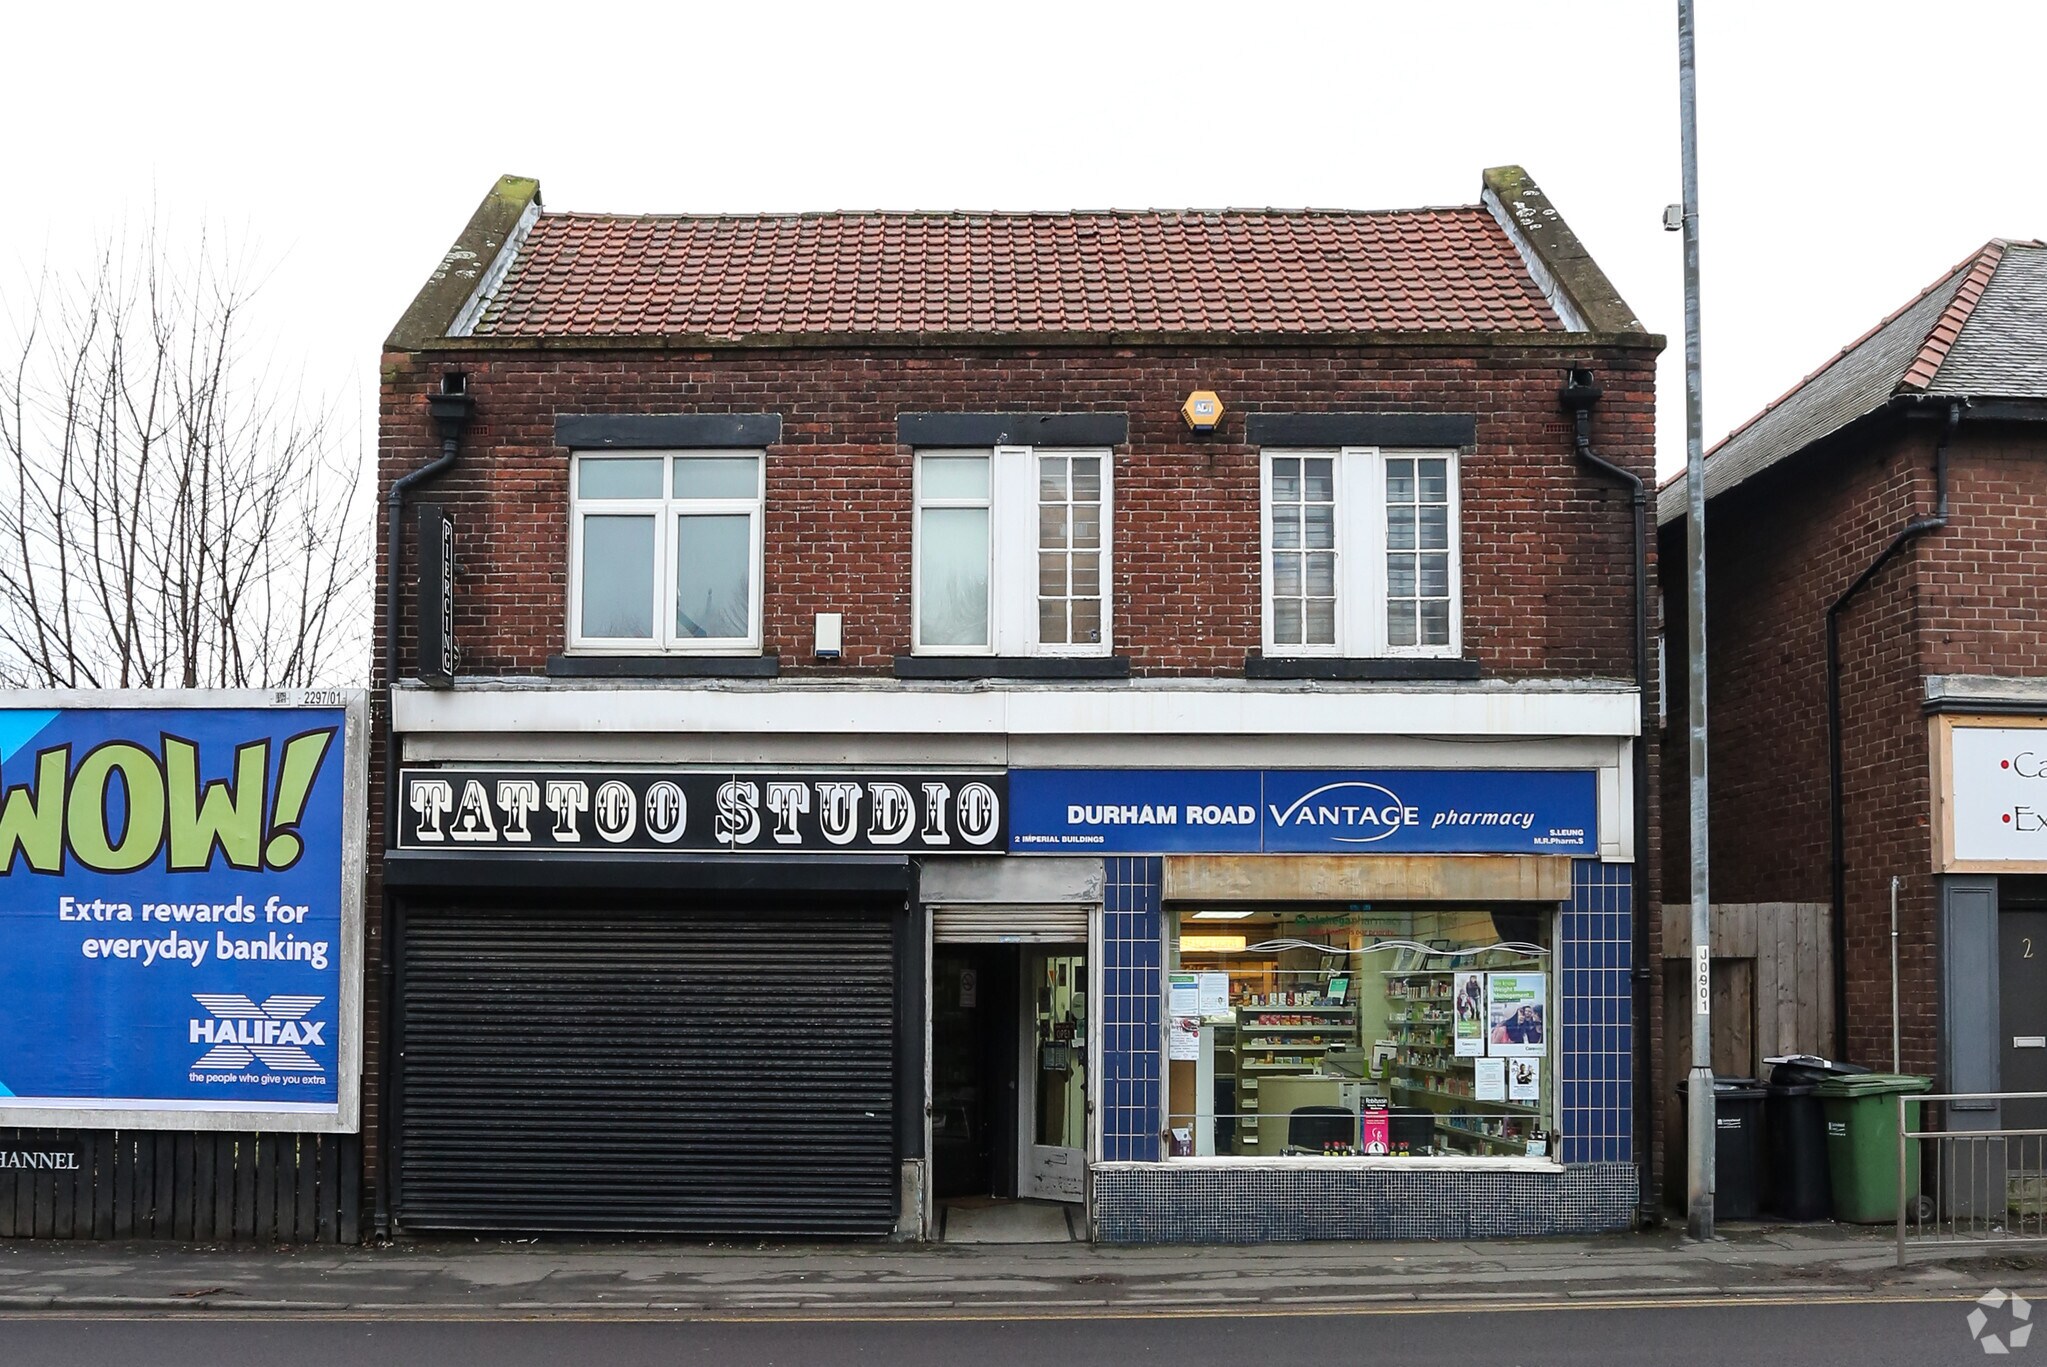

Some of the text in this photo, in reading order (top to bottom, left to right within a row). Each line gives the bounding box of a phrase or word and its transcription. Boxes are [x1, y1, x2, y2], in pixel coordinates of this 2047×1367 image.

[1195, 402, 1214, 413] ADT
[304, 691, 341, 704] 2297/01
[0, 726, 339, 877] WOW!
[410, 779, 1000, 846] TATTOO STUDIO
[1067, 805, 1256, 825] DURHAM ROAD
[1431, 809, 1535, 829] pharmacy
[1022, 835, 1060, 843] IMPERIAL
[1061, 835, 1104, 843] BUILDINGS
[59, 896, 309, 924] Extra rewards for
[81, 931, 328, 969] everyday banking
[2022, 937, 2034, 959] 2
[1700, 948, 1708, 1011] J0901
[189, 1019, 326, 1046] HALIFAX
[188, 1073, 326, 1085] the people who give you extra
